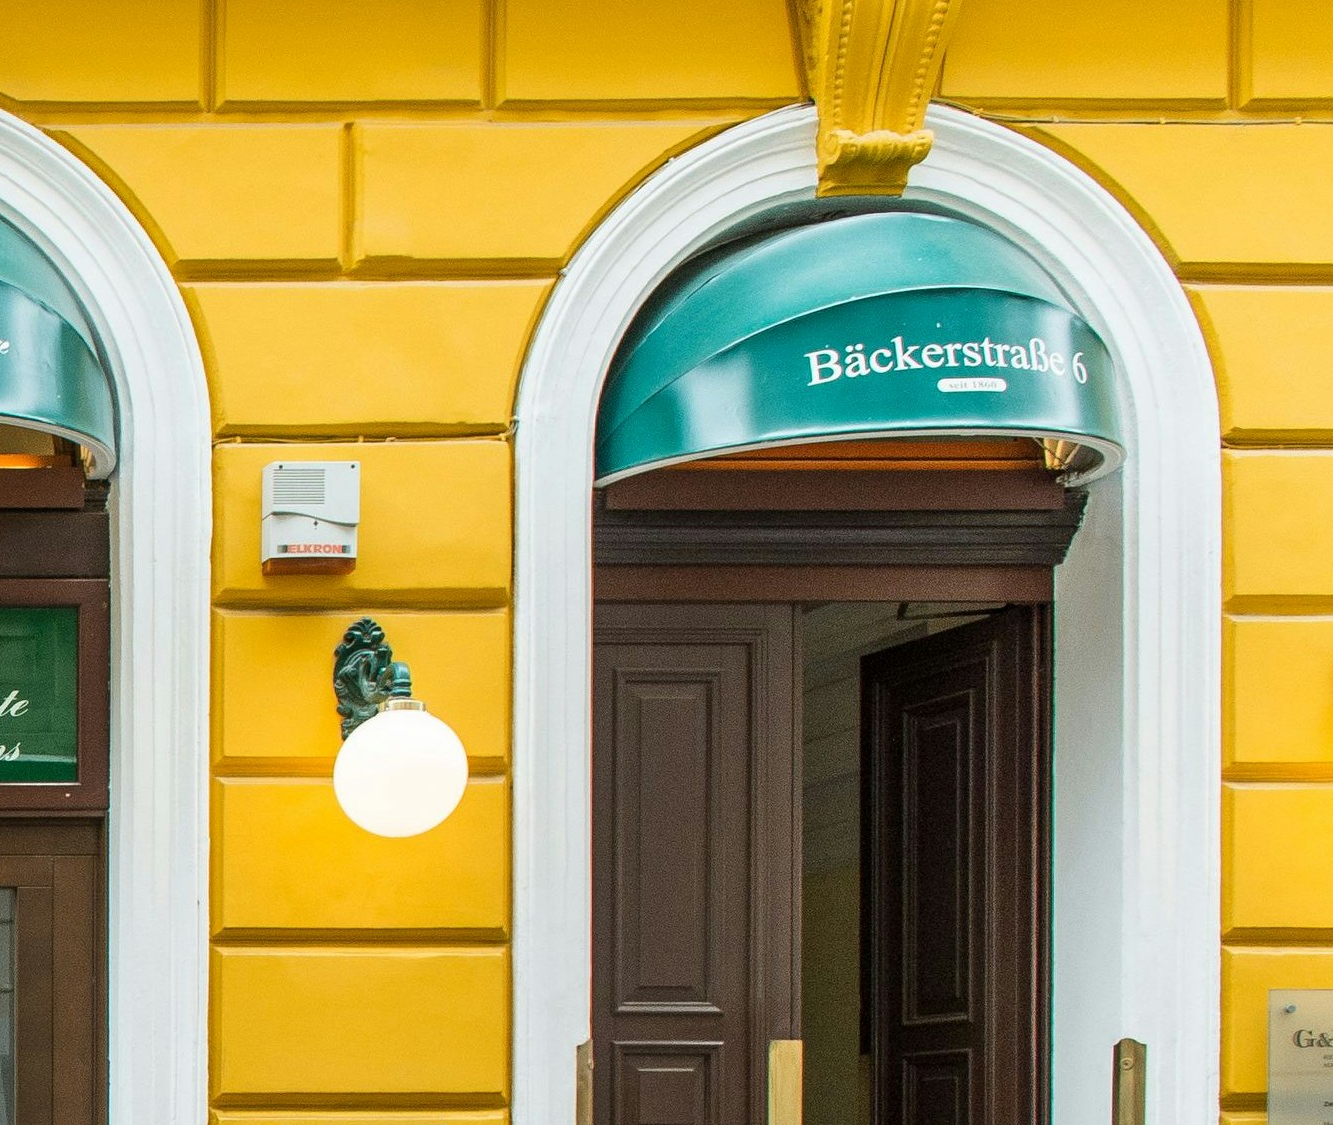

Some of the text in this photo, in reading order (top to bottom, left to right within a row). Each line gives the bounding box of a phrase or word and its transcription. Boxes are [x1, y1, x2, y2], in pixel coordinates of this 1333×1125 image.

[804, 336, 1088, 386] Bäckerstraße 6
[287, 543, 343, 554] ELKRON
